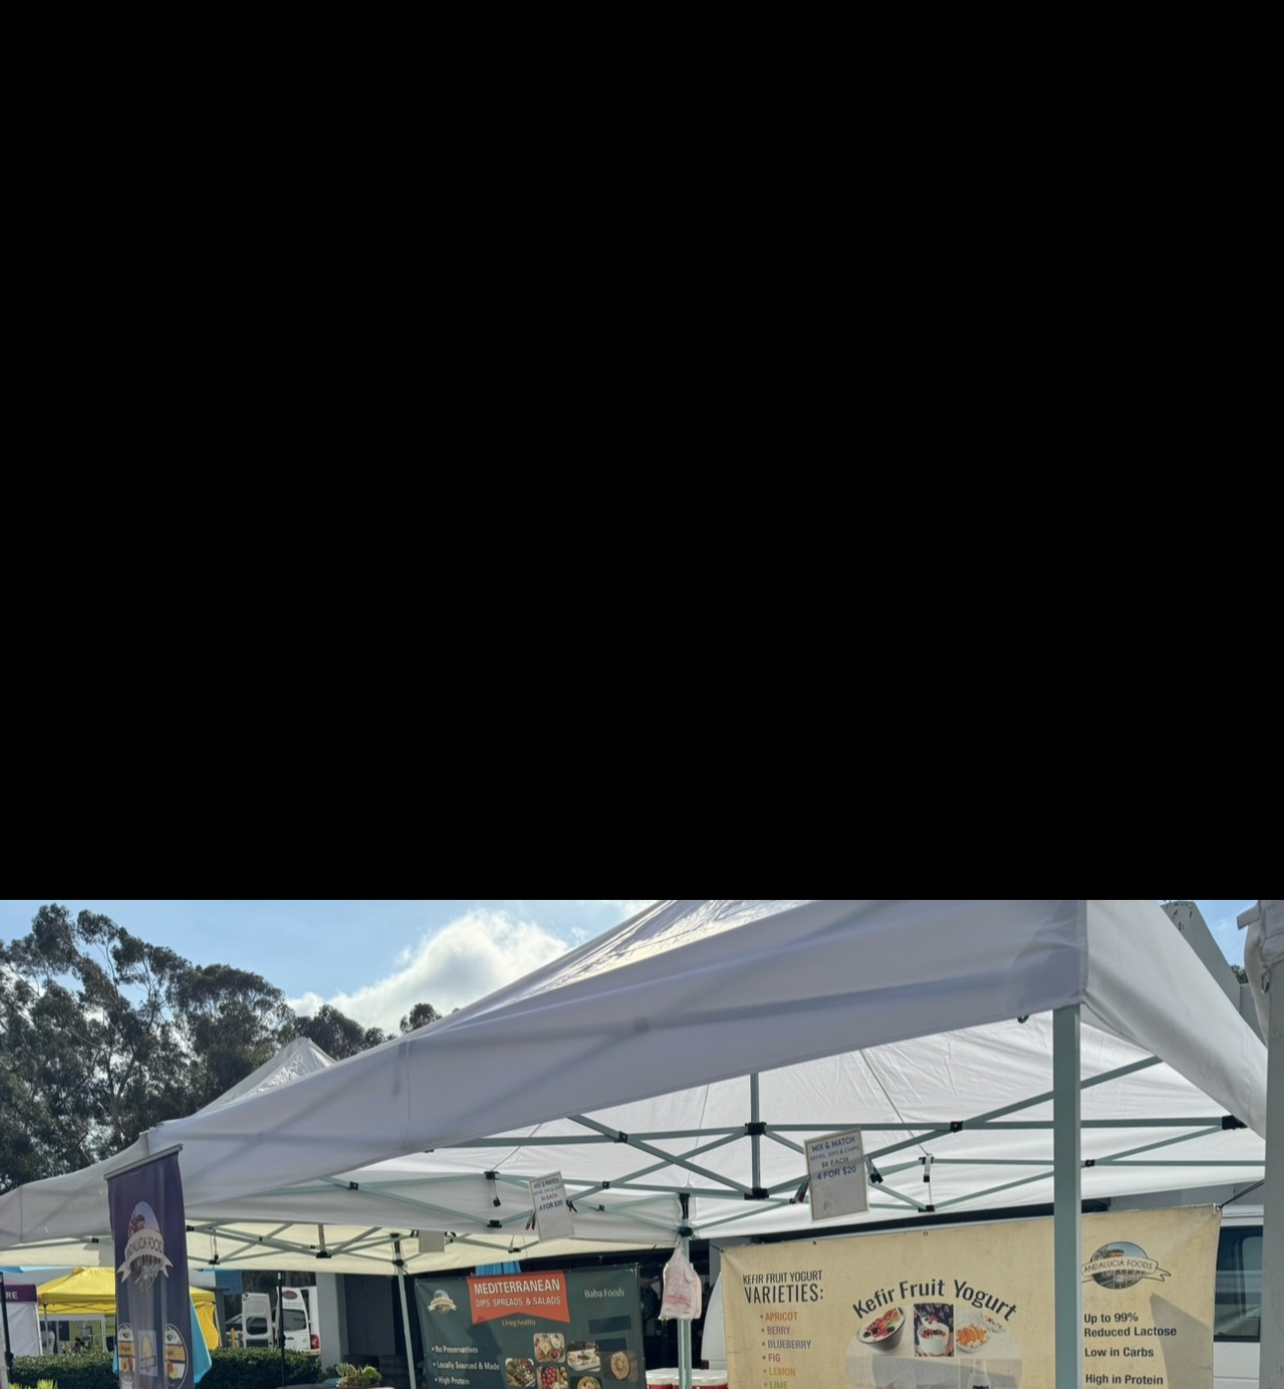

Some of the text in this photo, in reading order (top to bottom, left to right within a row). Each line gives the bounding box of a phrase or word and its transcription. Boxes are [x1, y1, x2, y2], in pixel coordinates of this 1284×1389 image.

[812, 1144, 824, 1152] MIX
[832, 1136, 855, 1147] MATCH
[816, 1165, 857, 1180] 4 FOR $20
[1084, 1259, 1153, 1273] ANDALUCIA FOODS
[743, 1270, 822, 1285] KEFIR FRUIT YOGURT
[474, 1278, 560, 1295] MEDITERRANEAN
[584, 1287, 625, 1299] Baba Foods
[744, 1283, 823, 1304] VARIETIES:
[476, 1296, 560, 1308] DIPS, SPREADS, & SALADS
[852, 1279, 1017, 1322] Kefir Fruit Yogurt
[765, 1312, 798, 1321] APRICOT
[1084, 1312, 1139, 1325] Up to 99%
[767, 1326, 790, 1335] BERRY
[1084, 1326, 1177, 1337] Reduced Lactose
[435, 1345, 479, 1354] No Preservatives
[768, 1340, 811, 1349] BLUEBERRY
[768, 1353, 781, 1362] FIG
[1084, 1347, 1154, 1357] Low in Carbs
[436, 1361, 499, 1370] Locally Sourced & Made
[769, 1368, 795, 1376] LEMON
[770, 1381, 788, 1389] LIME
[1085, 1374, 1164, 1385] High in Protein
